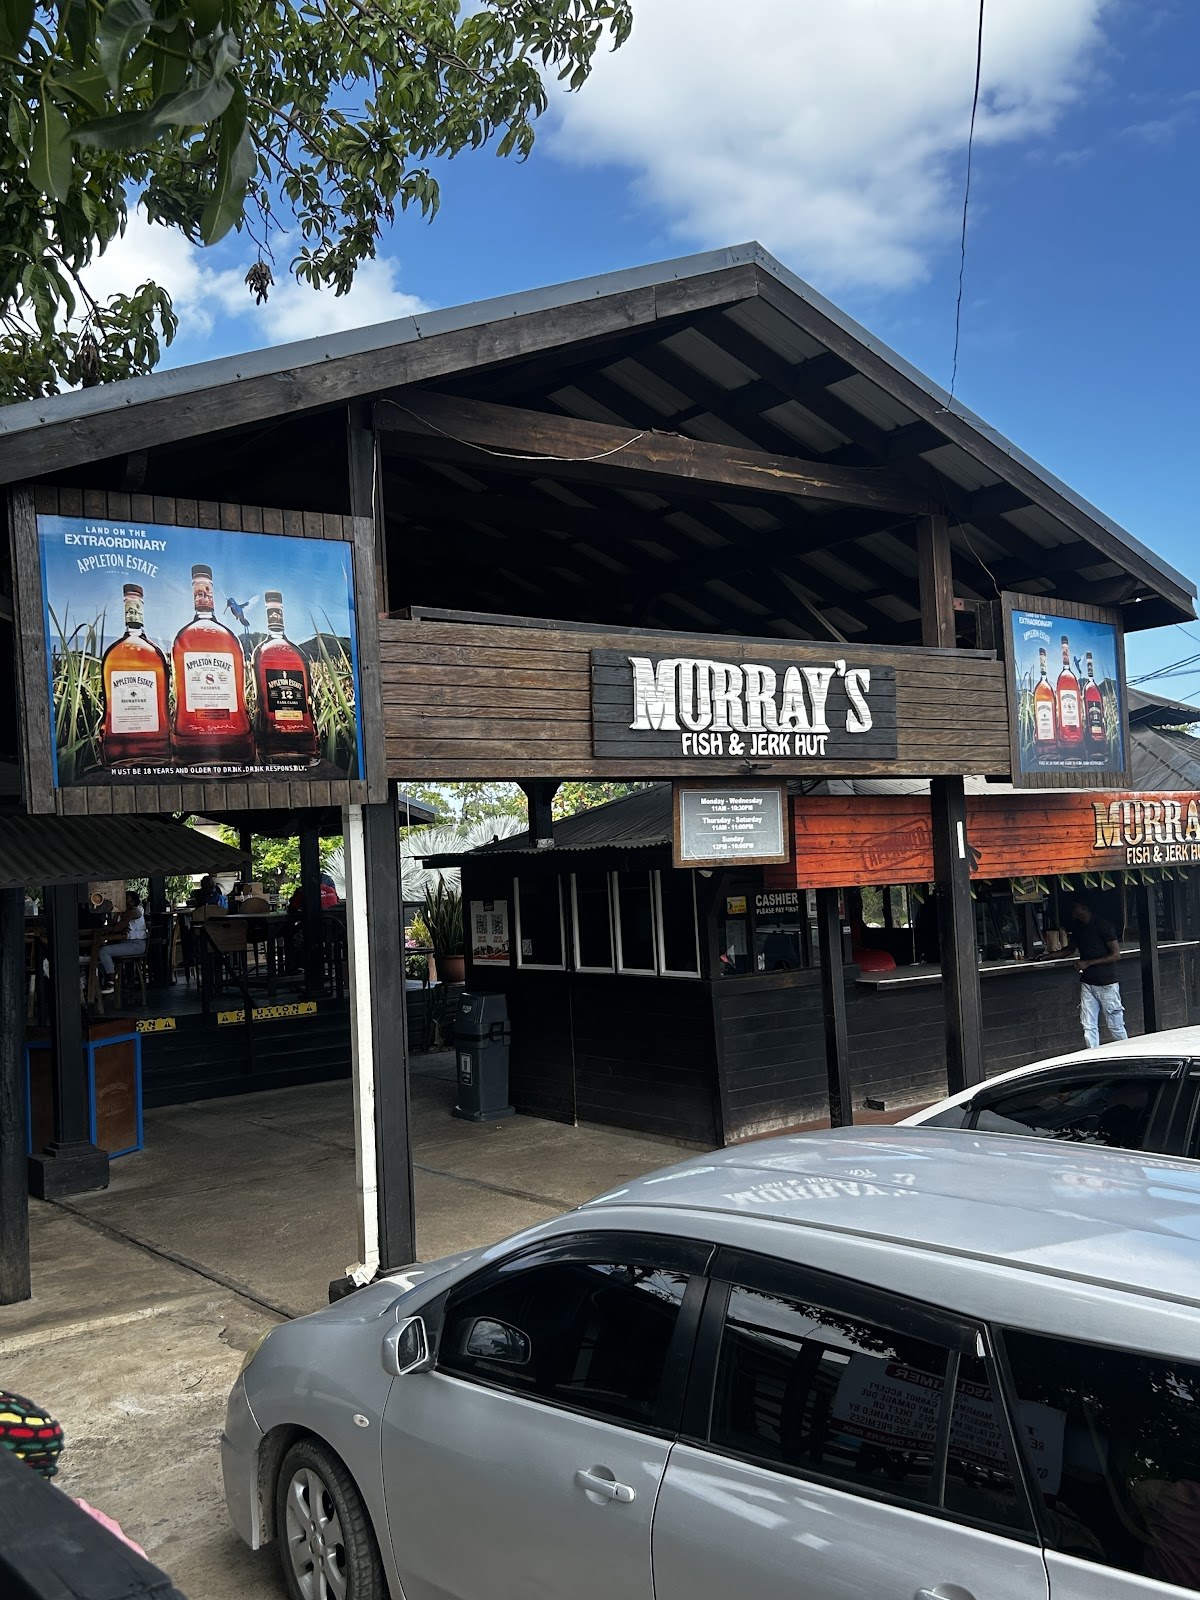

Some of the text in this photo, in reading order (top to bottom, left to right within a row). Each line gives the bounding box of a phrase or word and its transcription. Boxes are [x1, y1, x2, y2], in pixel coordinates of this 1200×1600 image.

[86, 526, 146, 537] LAND ON THE
[64, 534, 167, 551] EXTRAORDINARY
[76, 554, 158, 578] APPLETON ESTATE
[186, 658, 232, 672] APPLETON ESTATE
[113, 677, 154, 688] APPLETON ESTATE
[281, 690, 294, 700] 12
[627, 656, 873, 733] MURRAY'S
[682, 732, 828, 756] FISH & JERK HUT
[701, 798, 725, 806] Monday
[729, 797, 763, 805] Wednesday
[702, 817, 731, 825] Thursday
[735, 816, 763, 824] Saturday
[1091, 798, 1200, 849] MURRA
[1126, 846, 1151, 865] FISH
[1153, 845, 1163, 863] &
[1165, 843, 1189, 862] JERK
[755, 892, 799, 907] CASHIER
[756, 905, 799, 915] PLEASE PAY FIRST
